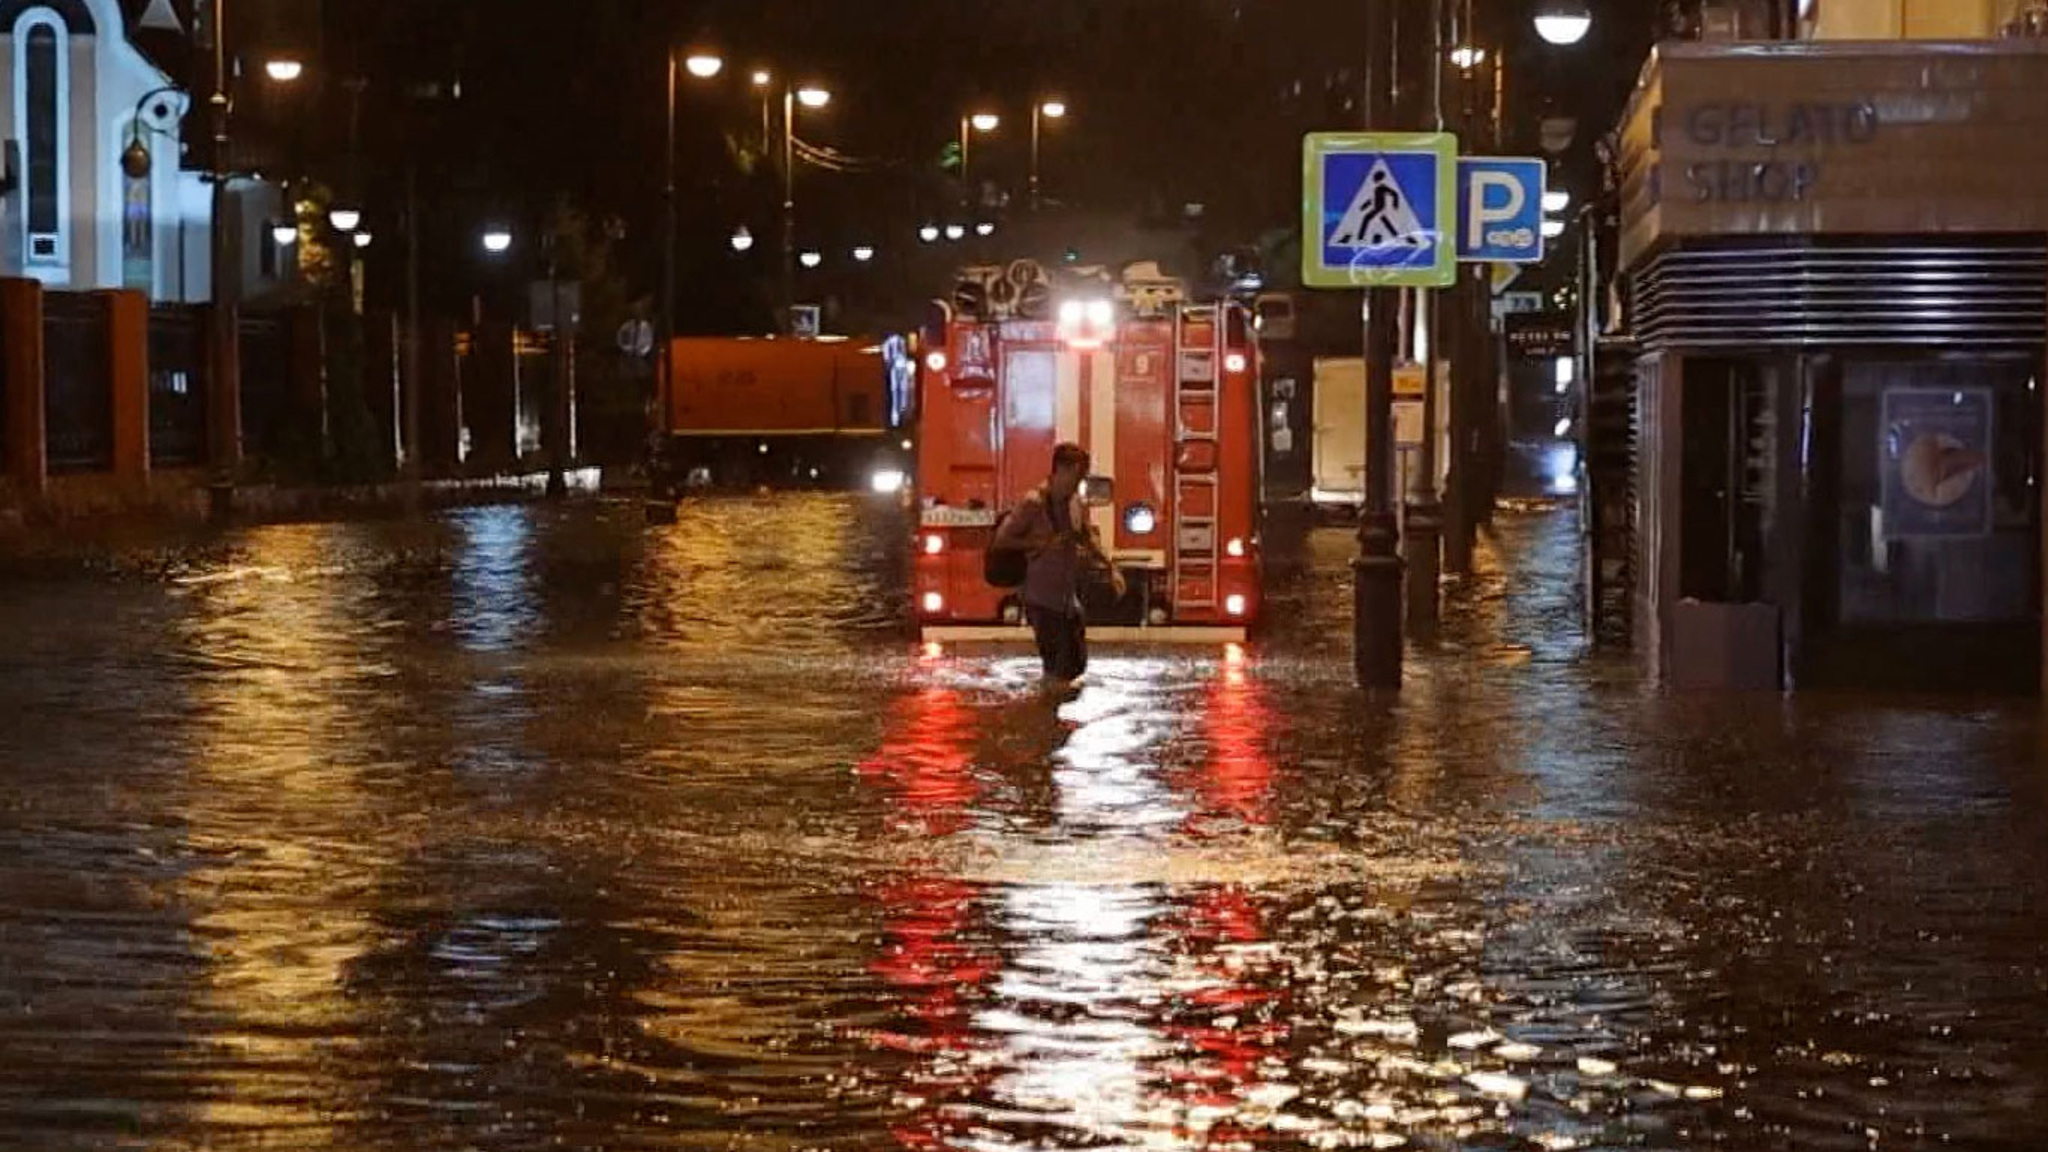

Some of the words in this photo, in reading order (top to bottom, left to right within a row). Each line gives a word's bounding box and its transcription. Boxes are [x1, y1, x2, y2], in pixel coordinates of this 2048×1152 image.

[1689, 103, 1878, 145] GELATO
[1687, 161, 1817, 204] SHOP
[1468, 171, 1525, 249] P
